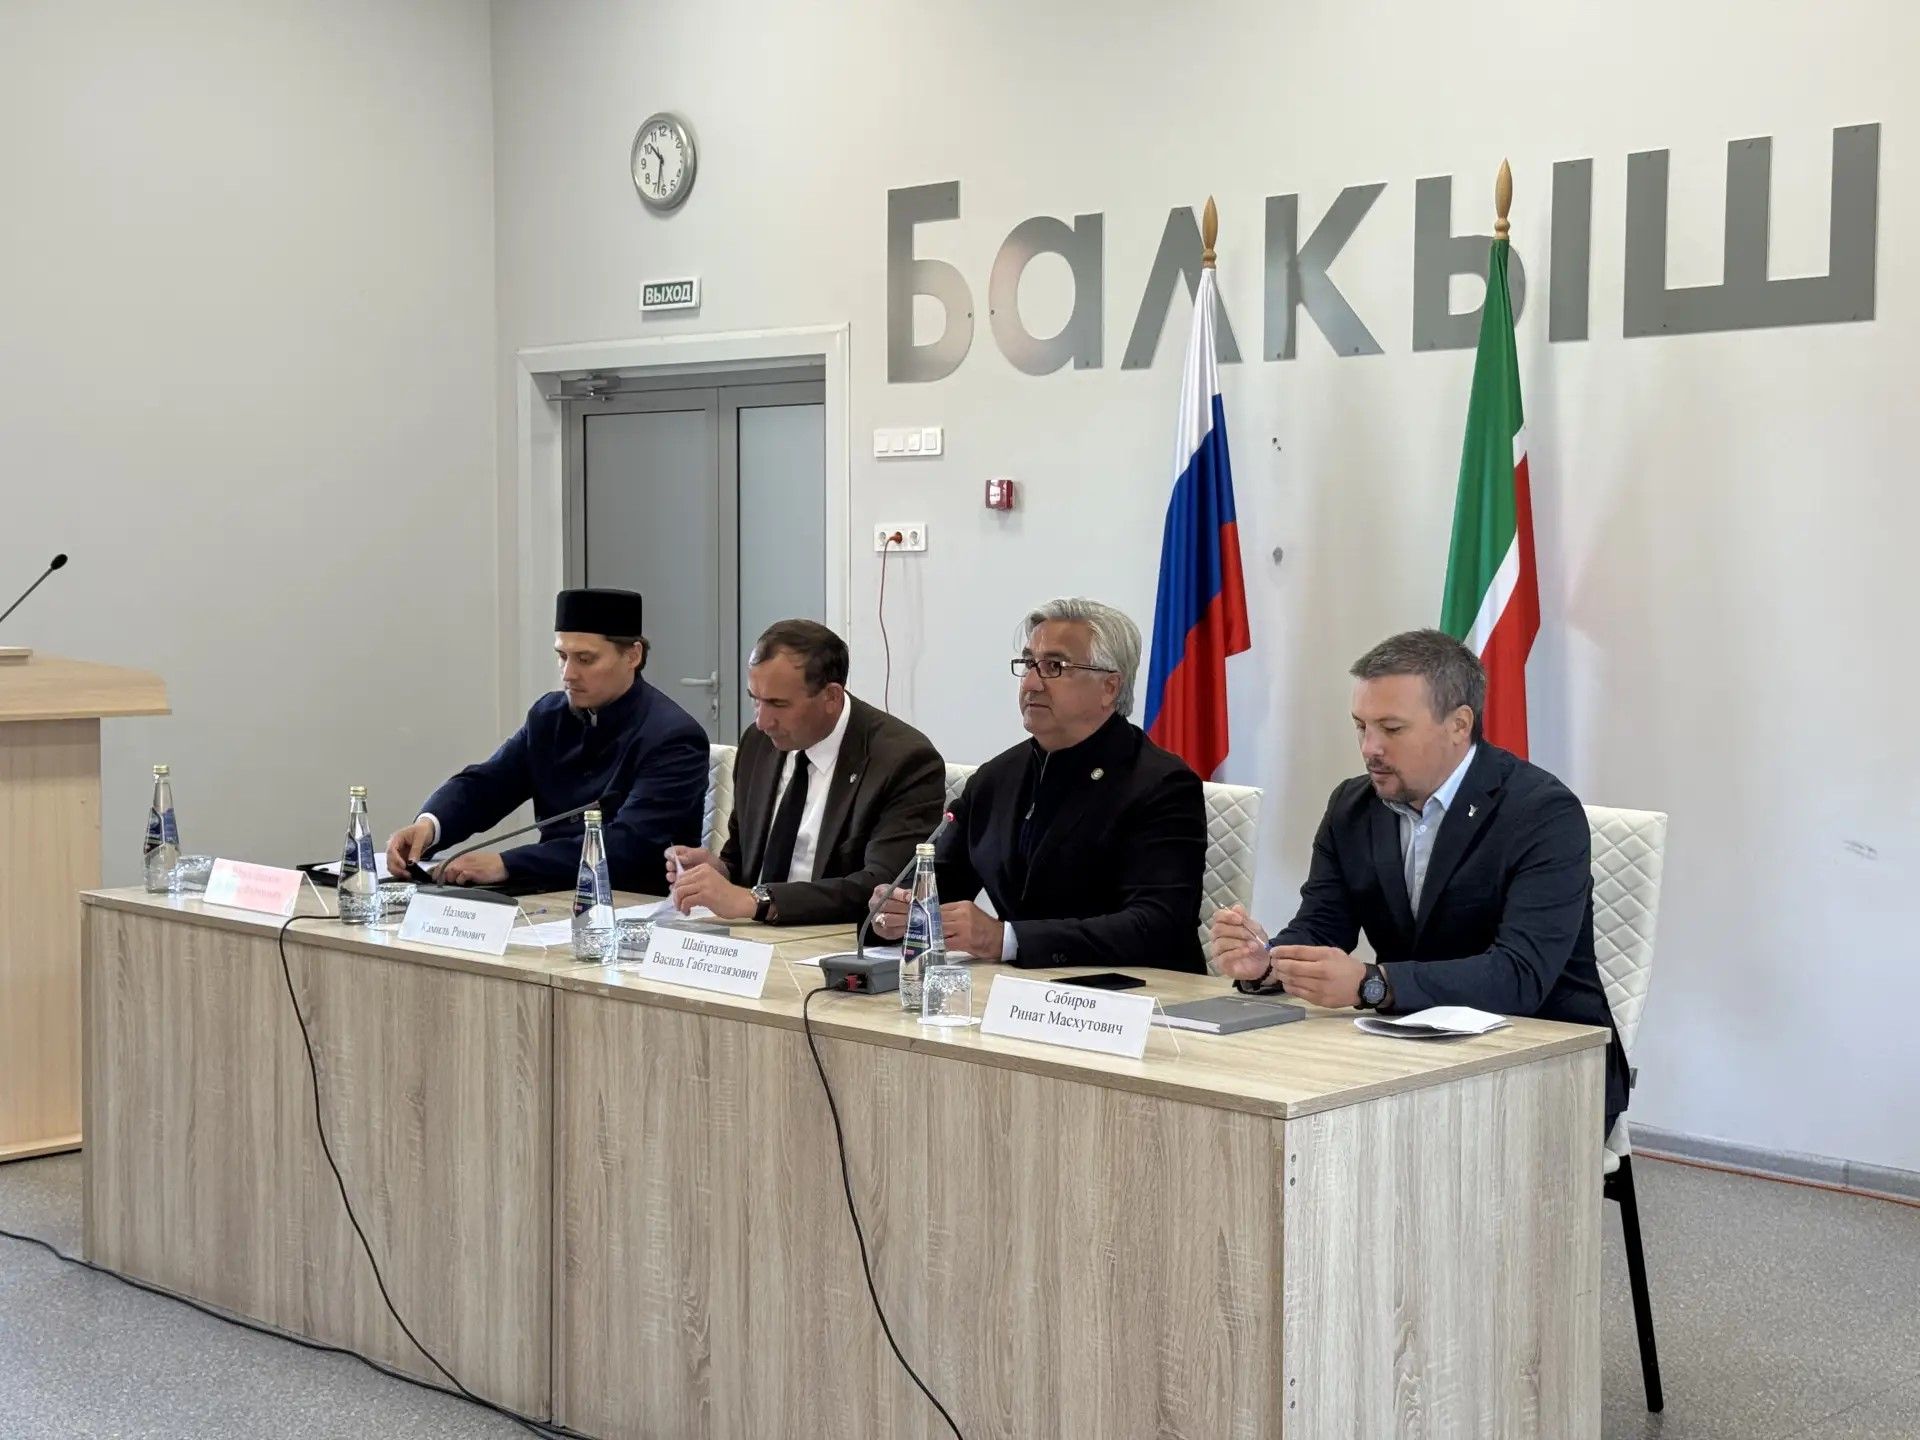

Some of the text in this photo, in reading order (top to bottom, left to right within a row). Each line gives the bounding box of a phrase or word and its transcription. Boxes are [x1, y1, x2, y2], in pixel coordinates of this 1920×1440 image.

[650, 131, 657, 142] 11
[658, 125, 667, 137] 12
[643, 143, 653, 155] 10
[640, 158, 647, 170] 9
[645, 173, 650, 185] 8
[652, 182, 658, 193] 7
[661, 184, 667, 196] 6
[886, 122, 1881, 384] Балкыш
[645, 284, 691, 304] ВЫХОД
[681, 937, 739, 957] Шайхразиев
[652, 951, 685, 968] Василь
[1045, 989, 1097, 1011] Сабиров
[1009, 1005, 1124, 1036] Ринат Масхутович
